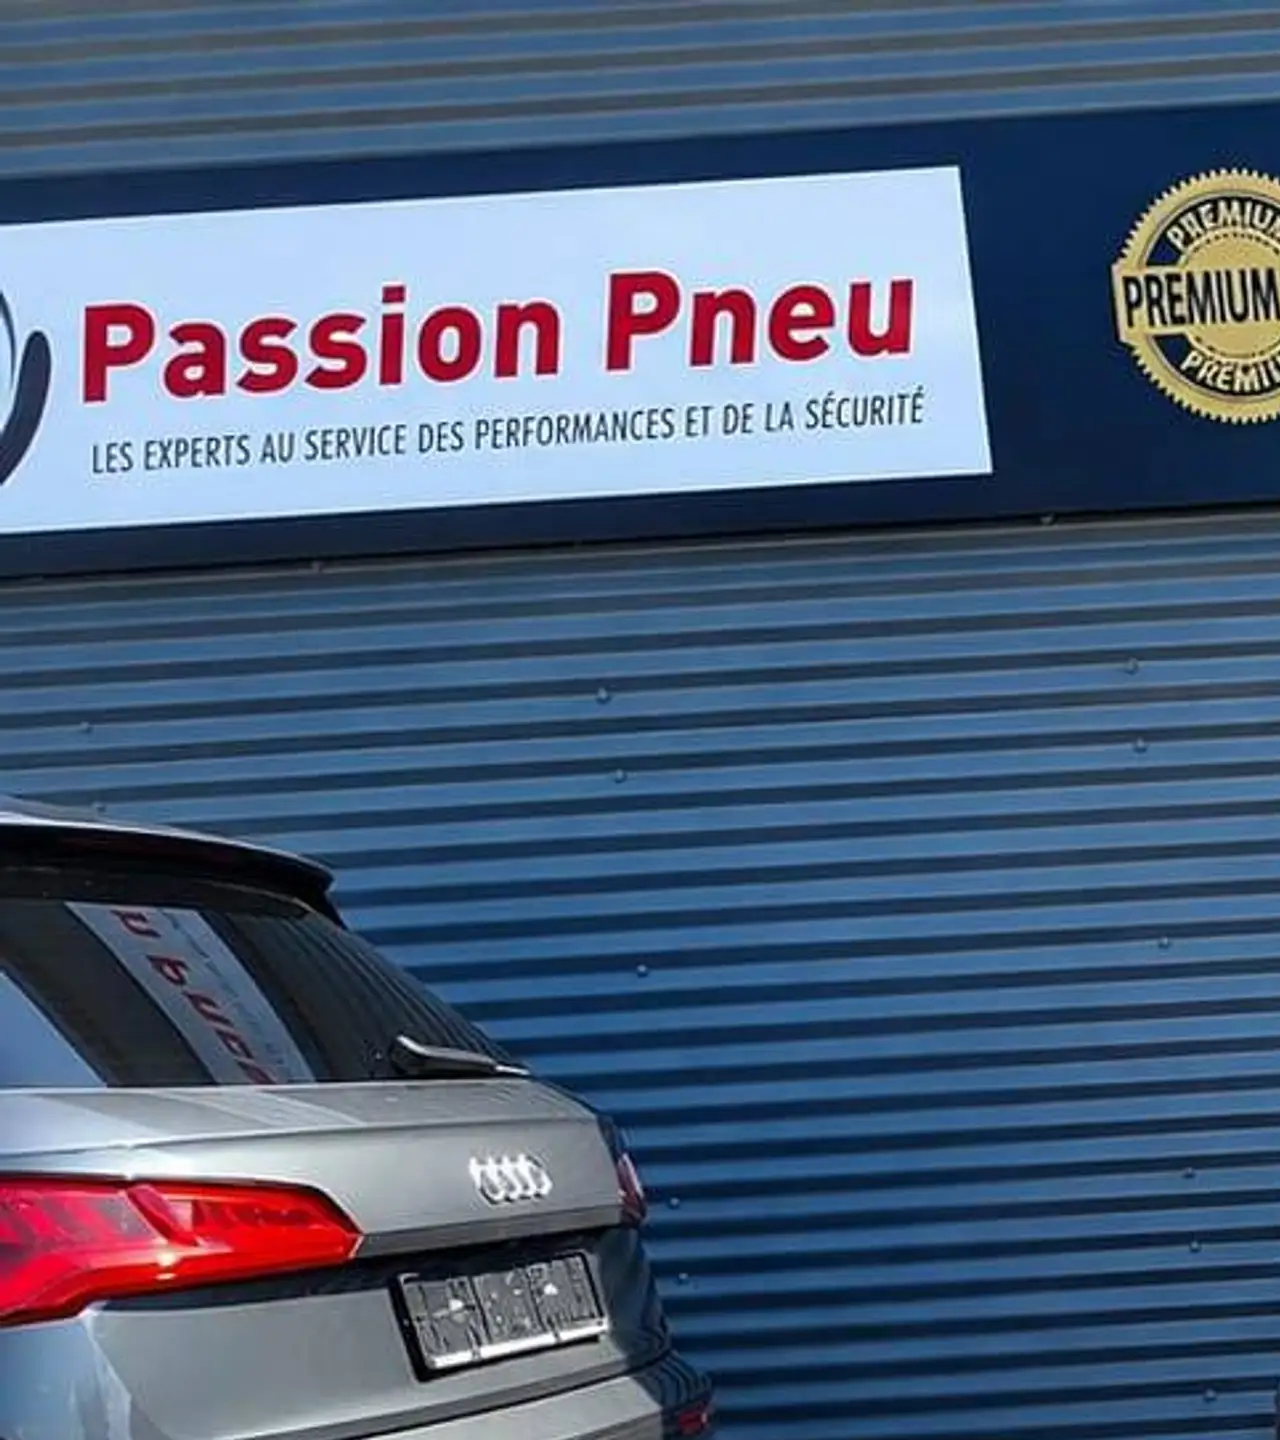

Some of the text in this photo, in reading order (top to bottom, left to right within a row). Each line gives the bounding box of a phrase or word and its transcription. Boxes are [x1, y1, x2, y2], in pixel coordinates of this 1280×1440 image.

[83, 271, 913, 403] Passion Pneu
[92, 384, 926, 474] LES EXPERTS AU SERVICE DES PERFORMANCES ET DE LA SÉCURITÉ
